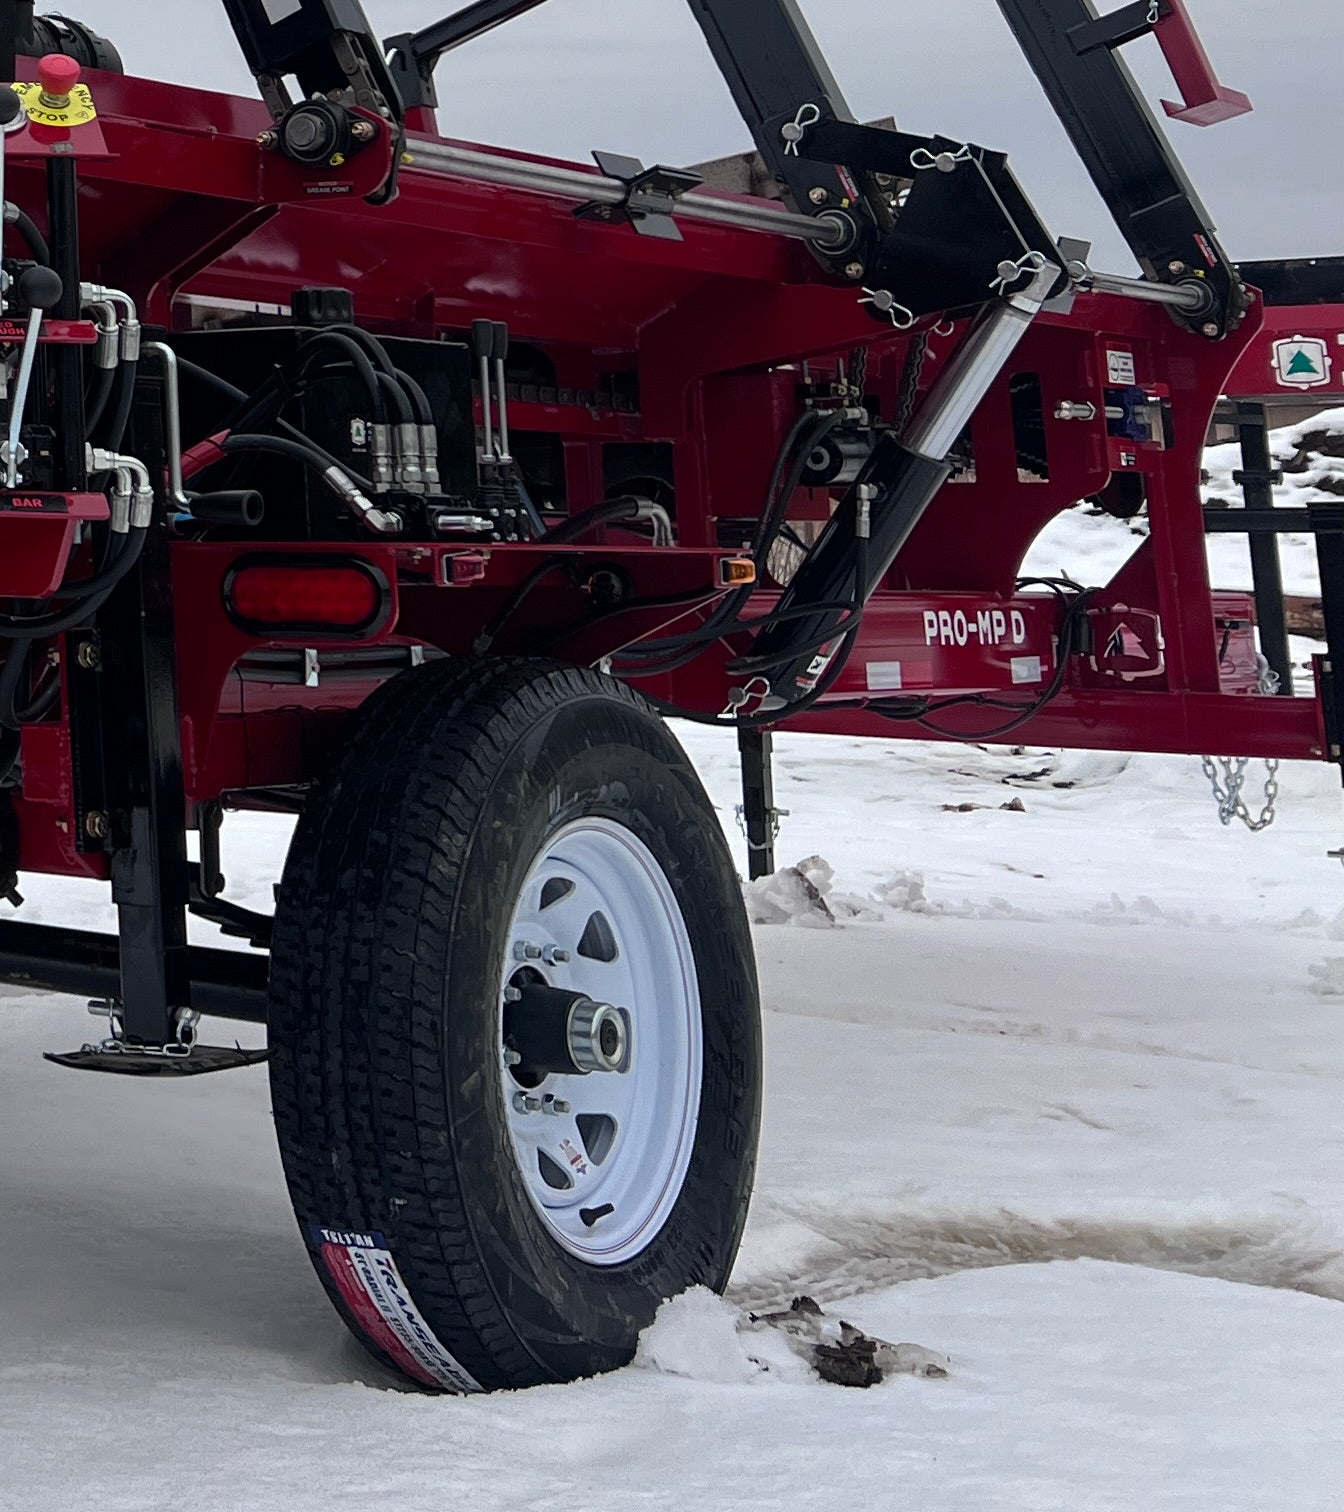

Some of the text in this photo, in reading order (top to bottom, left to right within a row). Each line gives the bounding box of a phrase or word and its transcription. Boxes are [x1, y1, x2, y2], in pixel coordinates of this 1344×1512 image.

[25, 107, 69, 122] STOP
[12, 497, 44, 508] BAR
[923, 609, 1006, 646] PRO-MP
